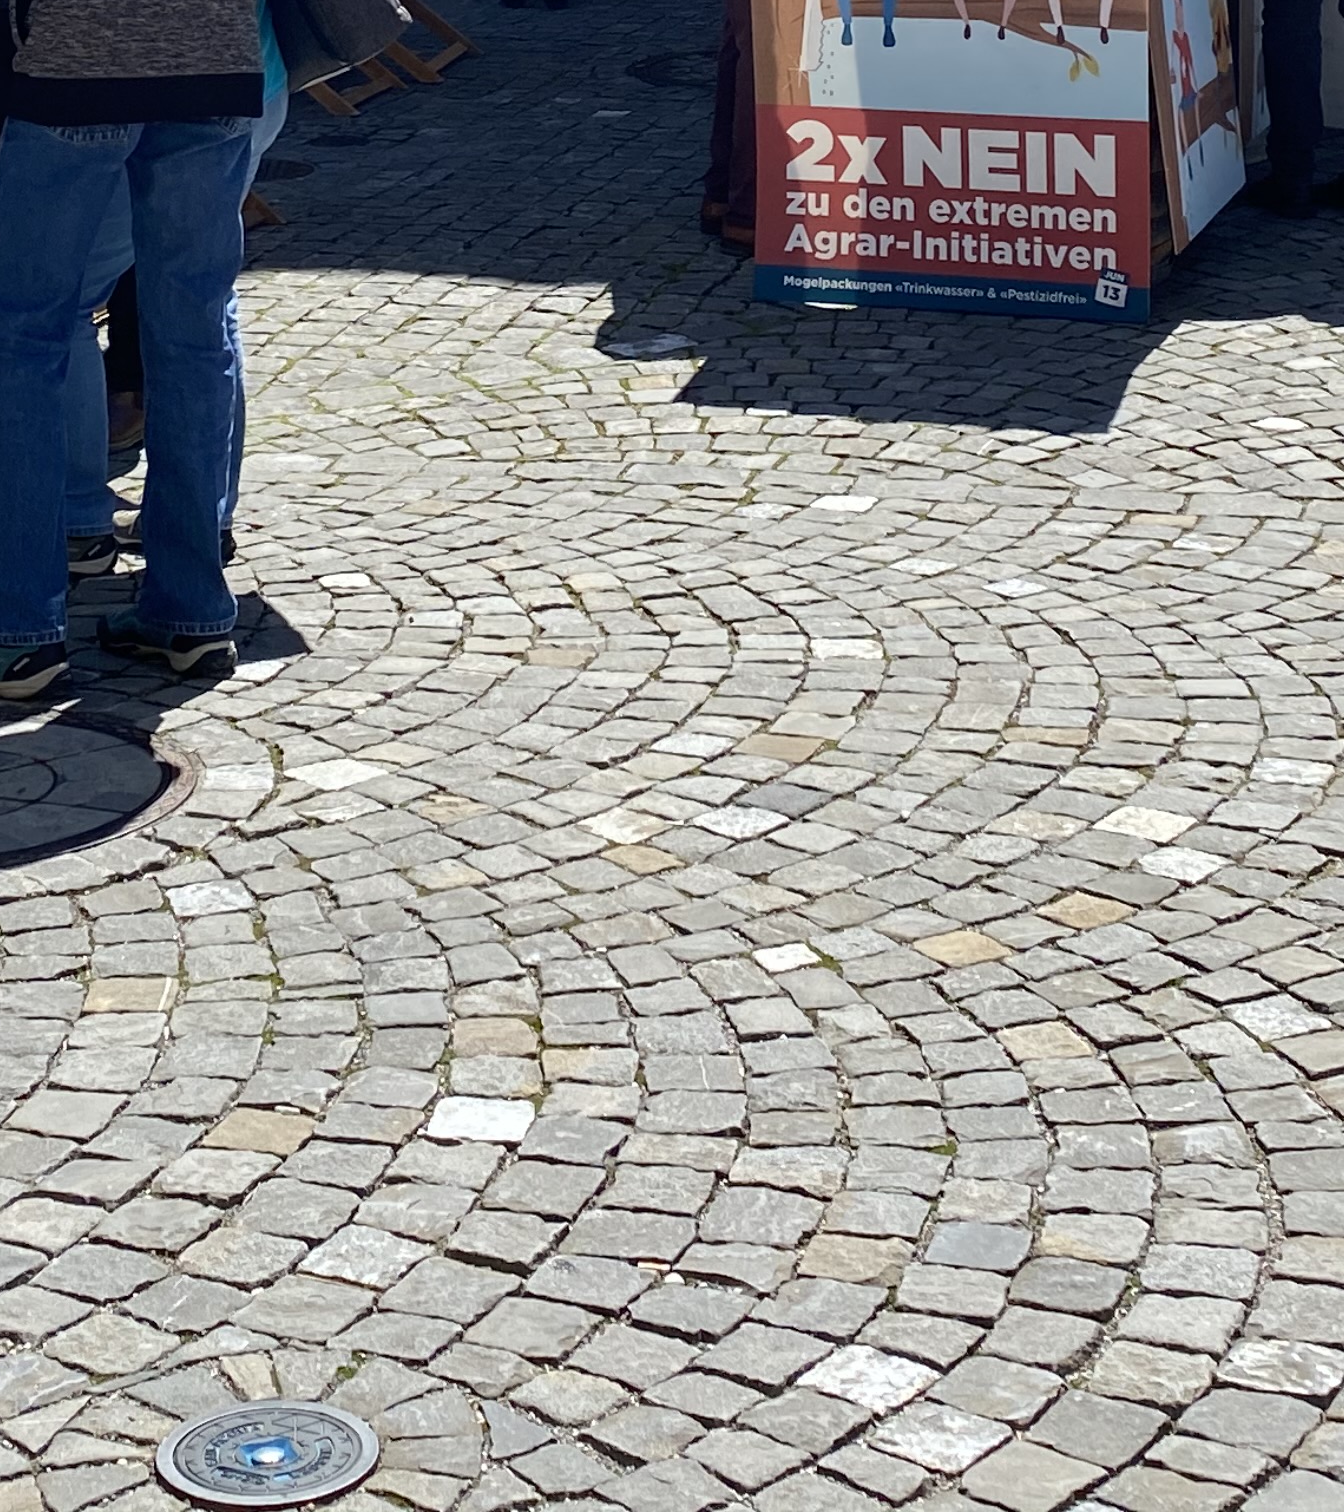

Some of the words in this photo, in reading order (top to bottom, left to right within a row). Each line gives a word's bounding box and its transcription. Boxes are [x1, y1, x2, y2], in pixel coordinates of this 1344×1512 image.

[786, 120, 888, 185] 2x
[902, 125, 1117, 198] NEIN
[786, 191, 829, 216] zu
[843, 188, 915, 221] den
[929, 196, 1117, 233] extremen
[784, 223, 1117, 271] Agrar-Initiativen
[783, 275, 892, 292] Mogelpackungen
[895, 281, 984, 298] «Trinkwasser»
[987, 287, 996, 298] &
[1102, 285, 1121, 301] 13
